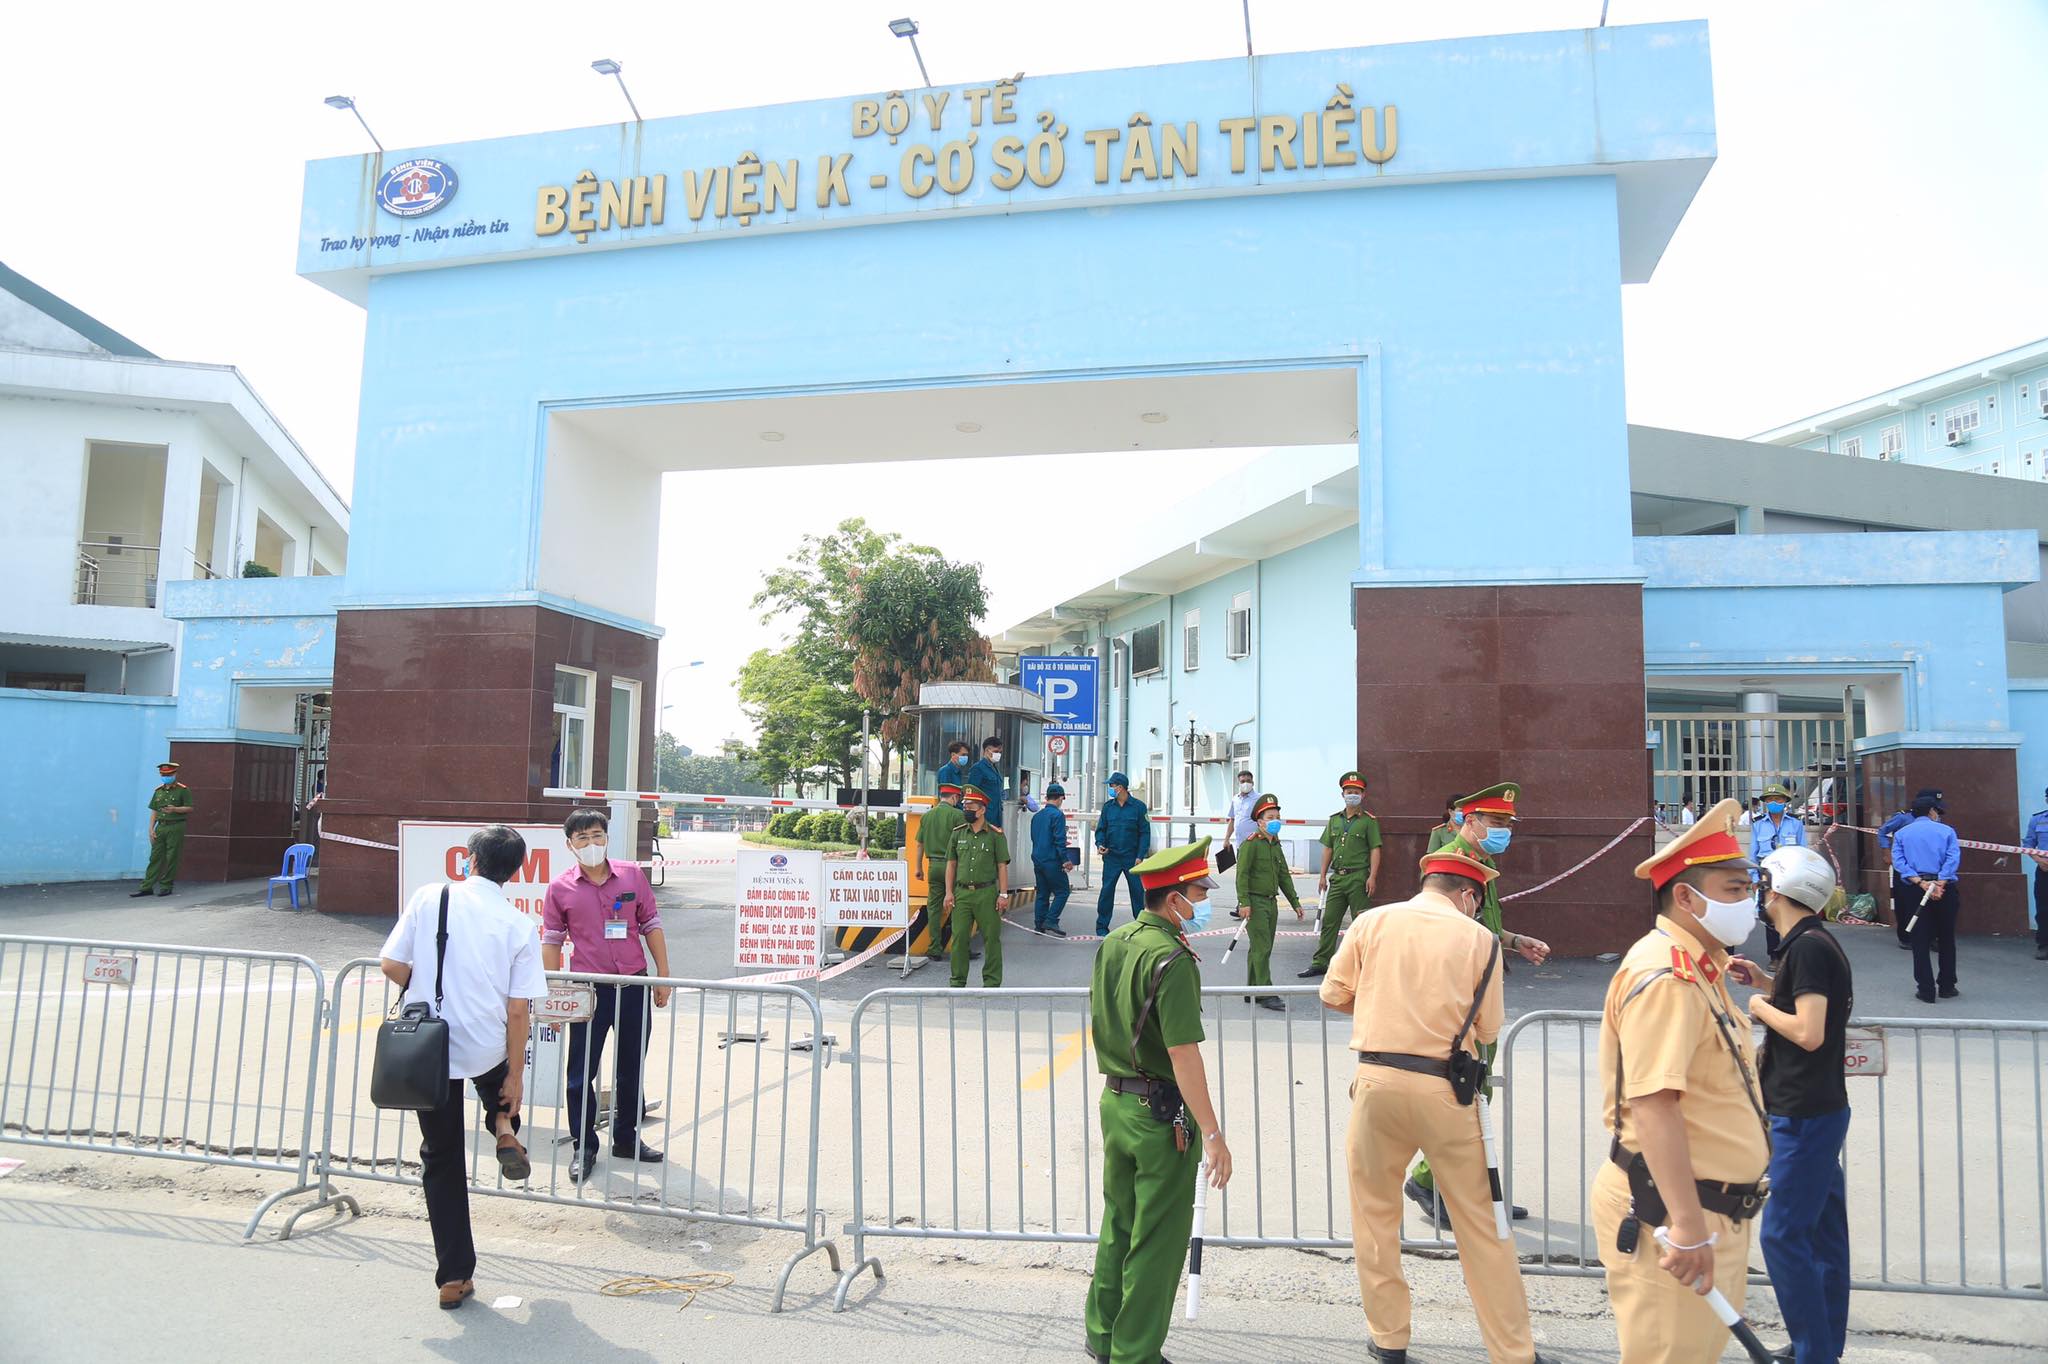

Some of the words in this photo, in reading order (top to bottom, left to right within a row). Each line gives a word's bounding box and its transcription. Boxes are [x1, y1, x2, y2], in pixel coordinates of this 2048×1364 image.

[852, 90, 909, 145] BỘ
[922, 91, 949, 131] Y
[963, 72, 1026, 126] TẾ
[535, 169, 666, 243] BỆNH
[682, 151, 798, 225] VIỆN
[816, 153, 853, 209] K
[901, 131, 976, 199] CƠ
[990, 111, 1067, 191] SỞ
[1084, 112, 1198, 184] TÂN
[1220, 83, 1398, 174] TRIỀU
[320, 238, 347, 252] Trao
[351, 236, 367, 251] hy
[370, 233, 401, 250] vọng
[413, 226, 449, 243] Nhận
[453, 219, 486, 236] niềm
[490, 219, 509, 234] tin
[1045, 678, 1078, 712] P
[446, 846, 549, 883] CM
[753, 875, 774, 885] BỆNH
[777, 876, 797, 885] VIỆN
[833, 867, 853, 881] CẤM
[856, 869, 874, 881] CÁC
[878, 871, 897, 883] LOẠI
[778, 888, 796, 901] CÔNG
[797, 889, 810, 901] TÁC
[830, 888, 840, 902] XE
[843, 888, 860, 902] TAXI
[863, 886, 879, 902] VÀO
[882, 886, 902, 906] VIỆN
[740, 902, 764, 918] PHÒNG
[766, 906, 782, 921] DỊCH
[784, 906, 816, 919] COVID-19
[861, 908, 892, 921] KHÁCH
[752, 923, 769, 936] NGHỊ
[772, 922, 786, 935] CÁC
[789, 925, 798, 935] XE
[801, 923, 815, 936] VÀO
[740, 936, 758, 950] BỆNH
[760, 937, 776, 951] VIỆN
[778, 936, 794, 950] PHẢI
[761, 953, 773, 964] TRA
[777, 952, 800, 965] THÔNG
[803, 955, 815, 965] TIN
[94, 967, 122, 978] STOP
[545, 1000, 579, 1012] STOP
[1844, 1055, 1868, 1067] OP
